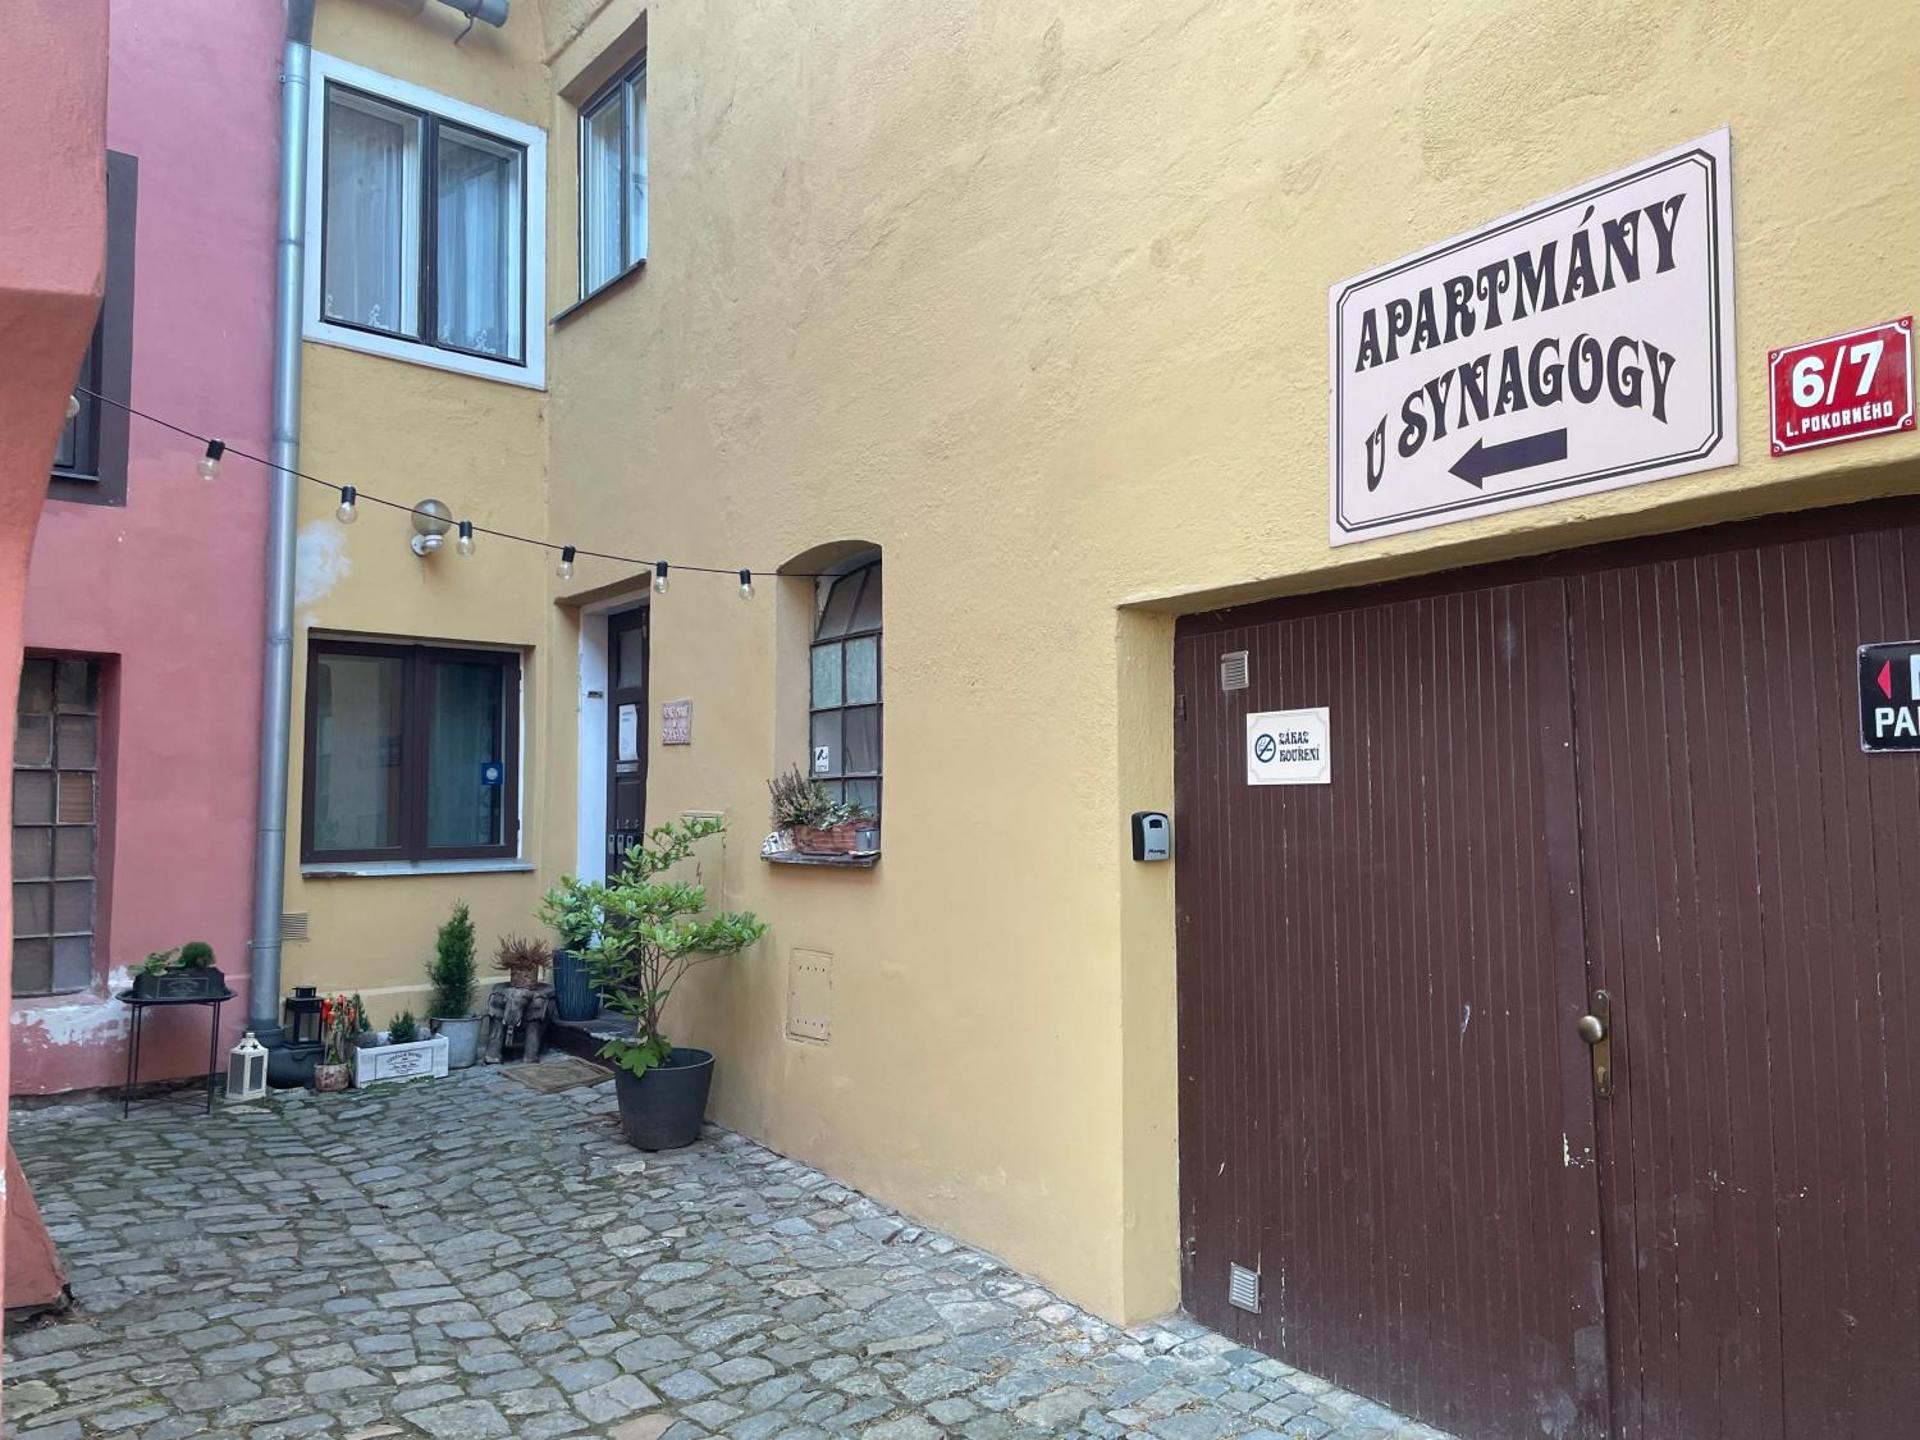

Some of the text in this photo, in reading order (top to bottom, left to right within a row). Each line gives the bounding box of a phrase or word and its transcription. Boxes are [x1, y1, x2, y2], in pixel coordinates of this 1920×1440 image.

[1354, 193, 1687, 373] APARTMÁNY
[1792, 340, 1884, 408] 6/7
[1365, 333, 1676, 492] U SYNAGOGY
[1786, 400, 1893, 437] L. POKORNÉHO
[1875, 706, 1920, 738] PA
